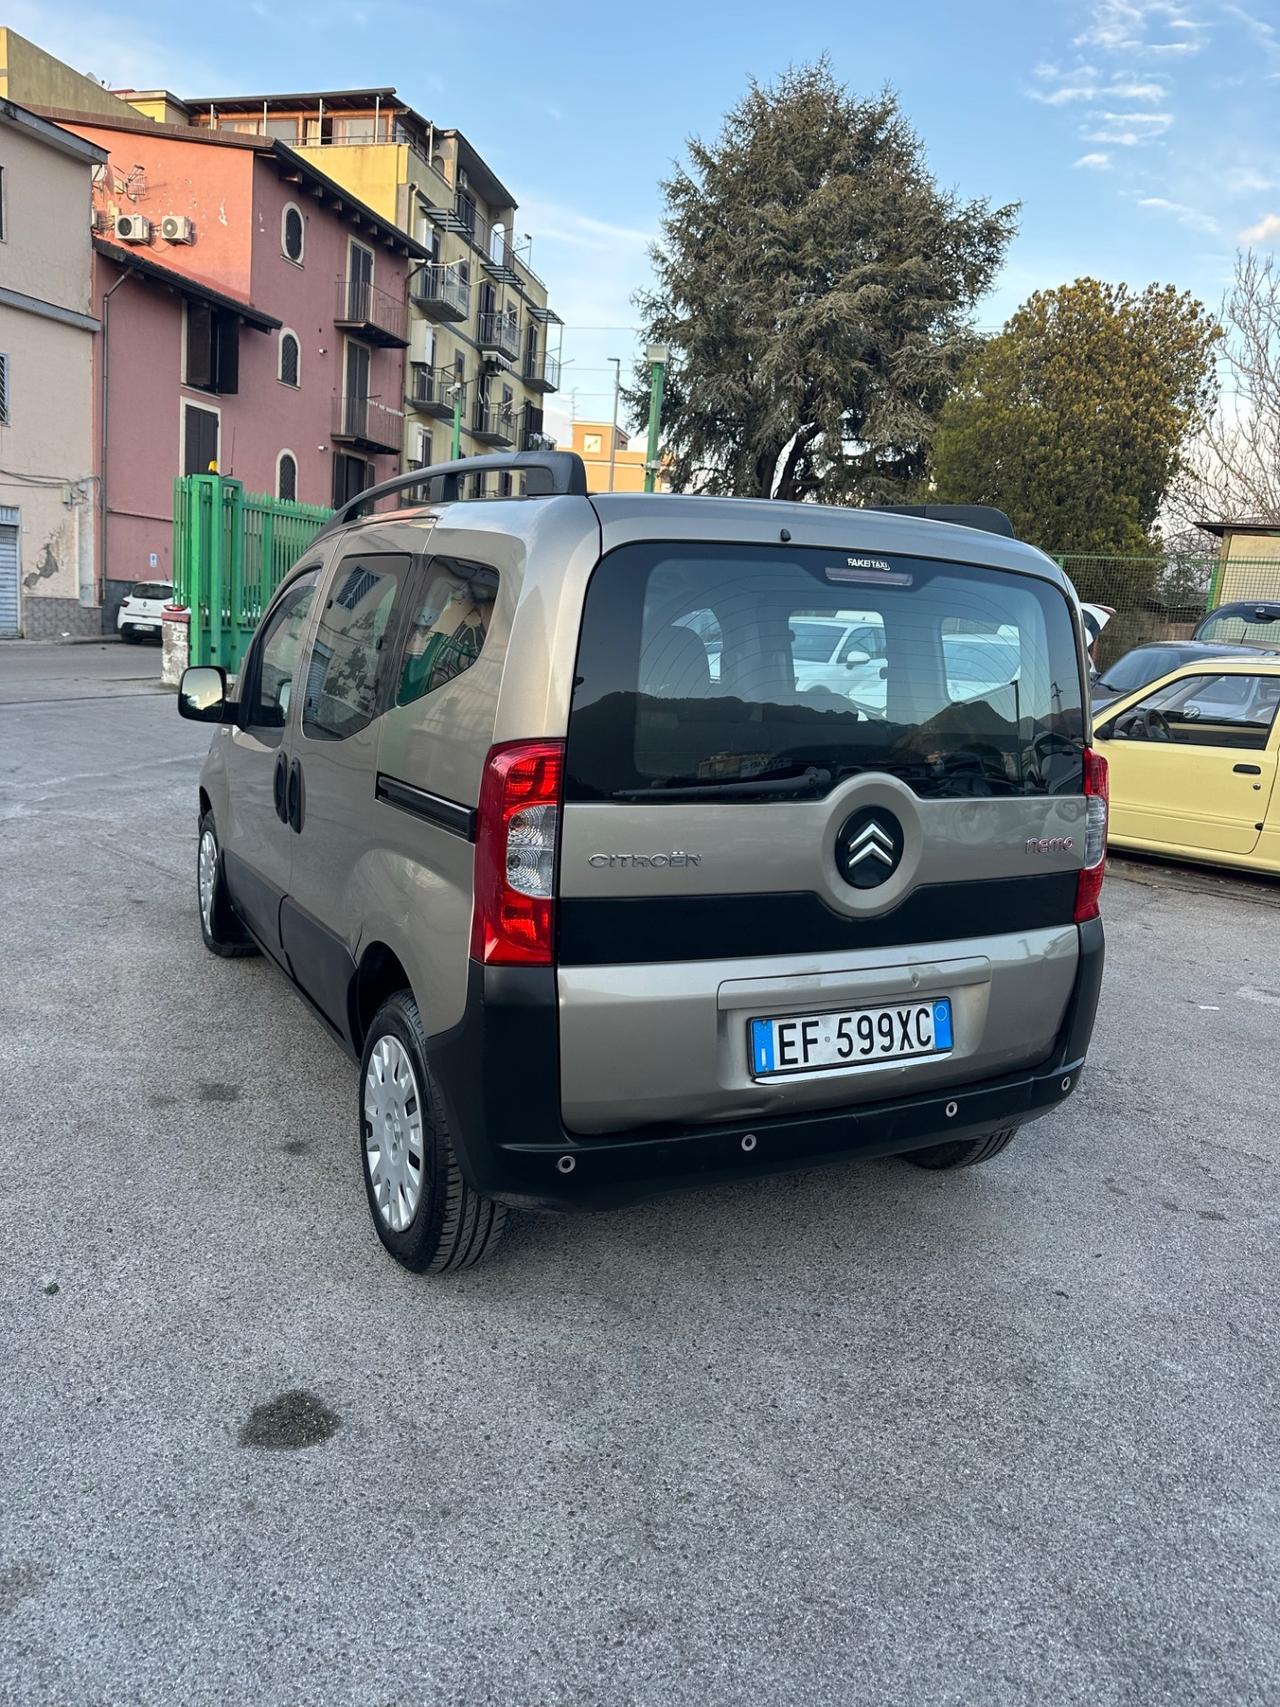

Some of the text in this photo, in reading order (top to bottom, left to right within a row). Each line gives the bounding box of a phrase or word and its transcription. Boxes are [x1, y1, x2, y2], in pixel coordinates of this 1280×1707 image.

[588, 851, 702, 869] CITROËN
[778, 1007, 932, 1066] EF 599XC
